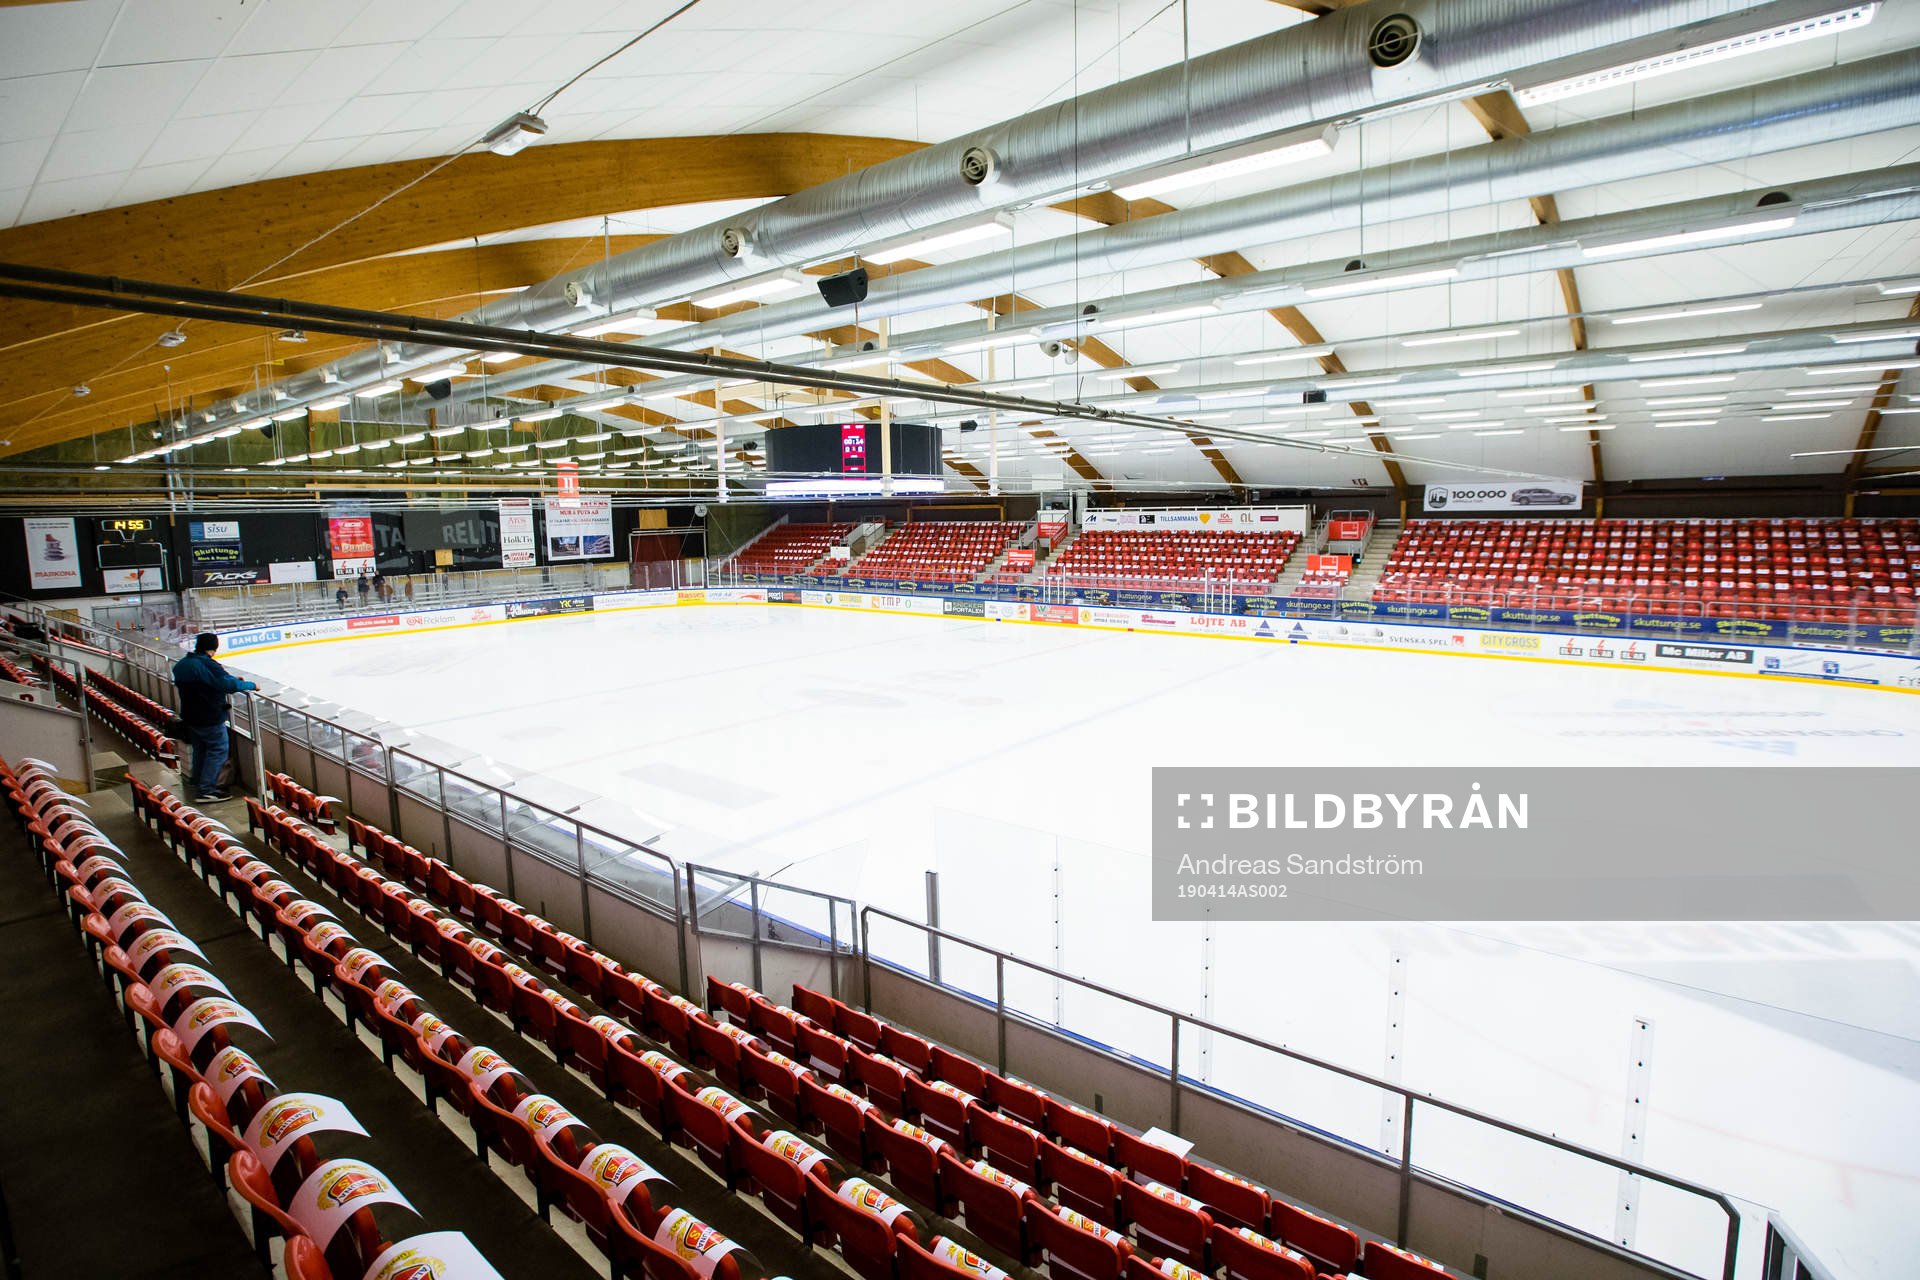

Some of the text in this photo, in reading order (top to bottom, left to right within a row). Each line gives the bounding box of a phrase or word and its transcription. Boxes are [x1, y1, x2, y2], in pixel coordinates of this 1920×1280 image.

[1160, 515, 1198, 523] TILLSAMMANS
[207, 523, 228, 534] sisu
[194, 547, 239, 557] Skuttunge
[204, 570, 258, 584] TACKS
[1286, 601, 1331, 610] skuttunge.se
[1387, 605, 1438, 616] skuttunge.se
[1449, 606, 1491, 616] Skuttunge
[1190, 614, 1247, 627] LÖJTE AB
[1502, 611, 1560, 623] skuttunge.se
[1573, 613, 1620, 623] Skuttunge
[1633, 617, 1702, 631] skuttunge.se
[1717, 620, 1772, 631] Skuttunge
[1389, 636, 1448, 646] SVENSKA SPEL
[1662, 646, 1747, 661] Mc Miller AB
